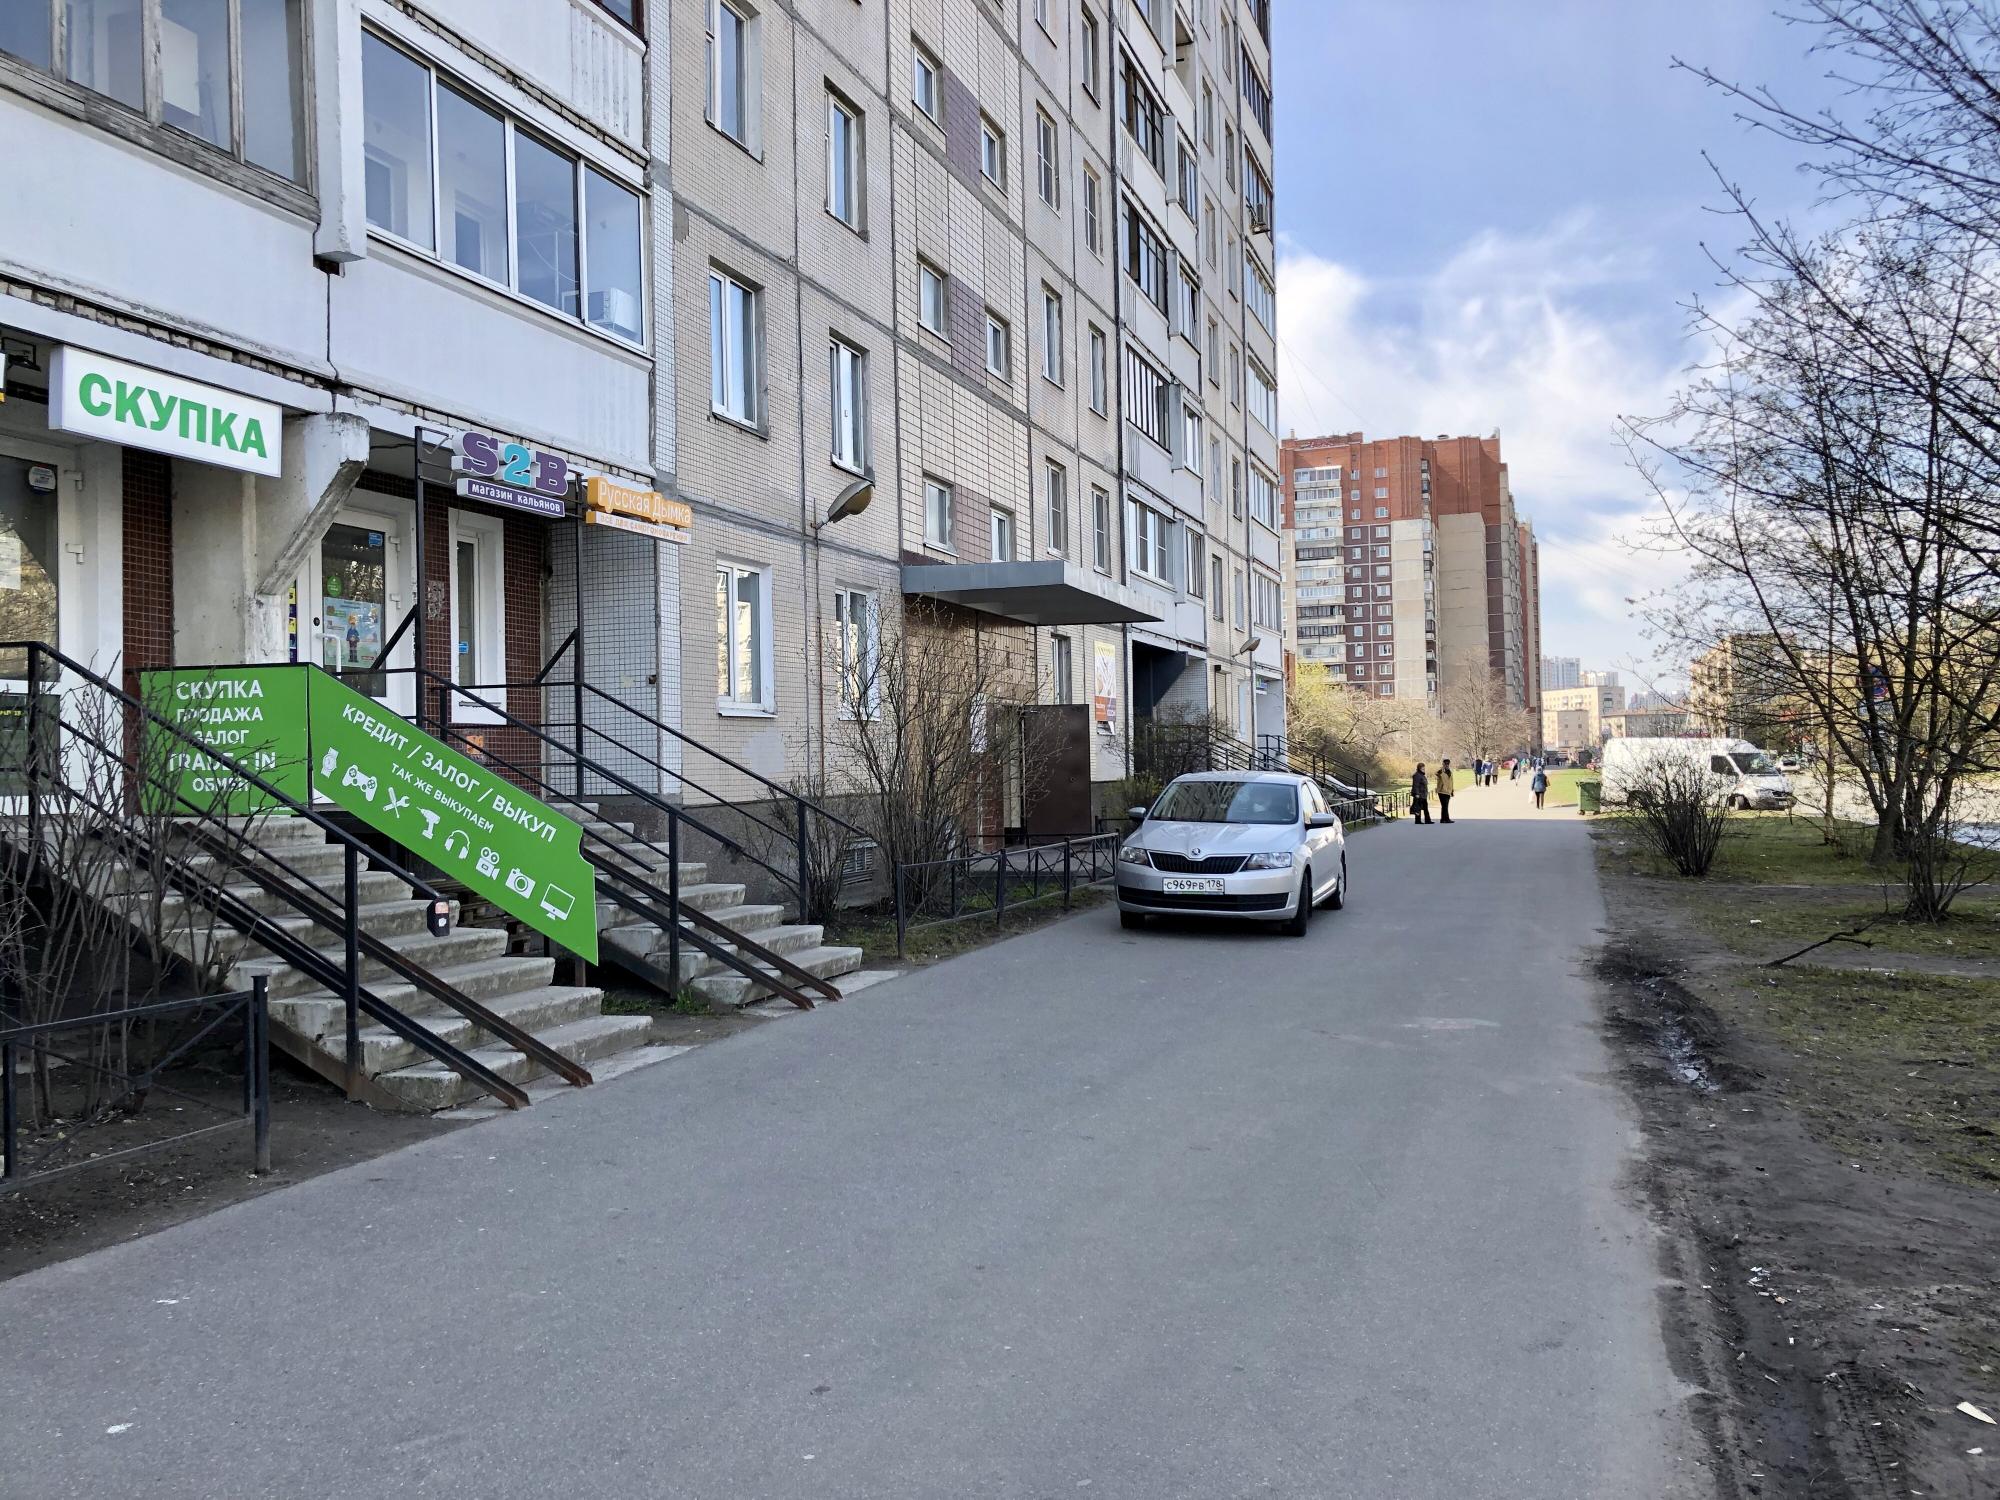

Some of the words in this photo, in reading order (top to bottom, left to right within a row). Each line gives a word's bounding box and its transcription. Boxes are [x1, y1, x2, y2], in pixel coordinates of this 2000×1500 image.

[79, 373, 267, 458] СКУПКА
[462, 431, 568, 496] S2B
[472, 484, 513, 501] магазин
[517, 494, 561, 512] кальянов
[600, 481, 650, 513] Русская
[652, 495, 691, 523] Дымка
[176, 680, 264, 700] СКУПКА
[176, 707, 263, 725] ПРОДАЖА
[193, 730, 250, 745] ЗАЛОГ
[255, 751, 277, 771] IN
[342, 703, 409, 751] КРЕДИТ
[421, 751, 481, 793] ЗАЛОГ
[491, 794, 557, 843] ВЫКУП
[192, 777, 249, 793] ОБМЕН
[391, 762, 414, 784] ТАК
[413, 776, 434, 796] ЖЕ
[433, 789, 495, 834] ВЫКУПАЕМ
